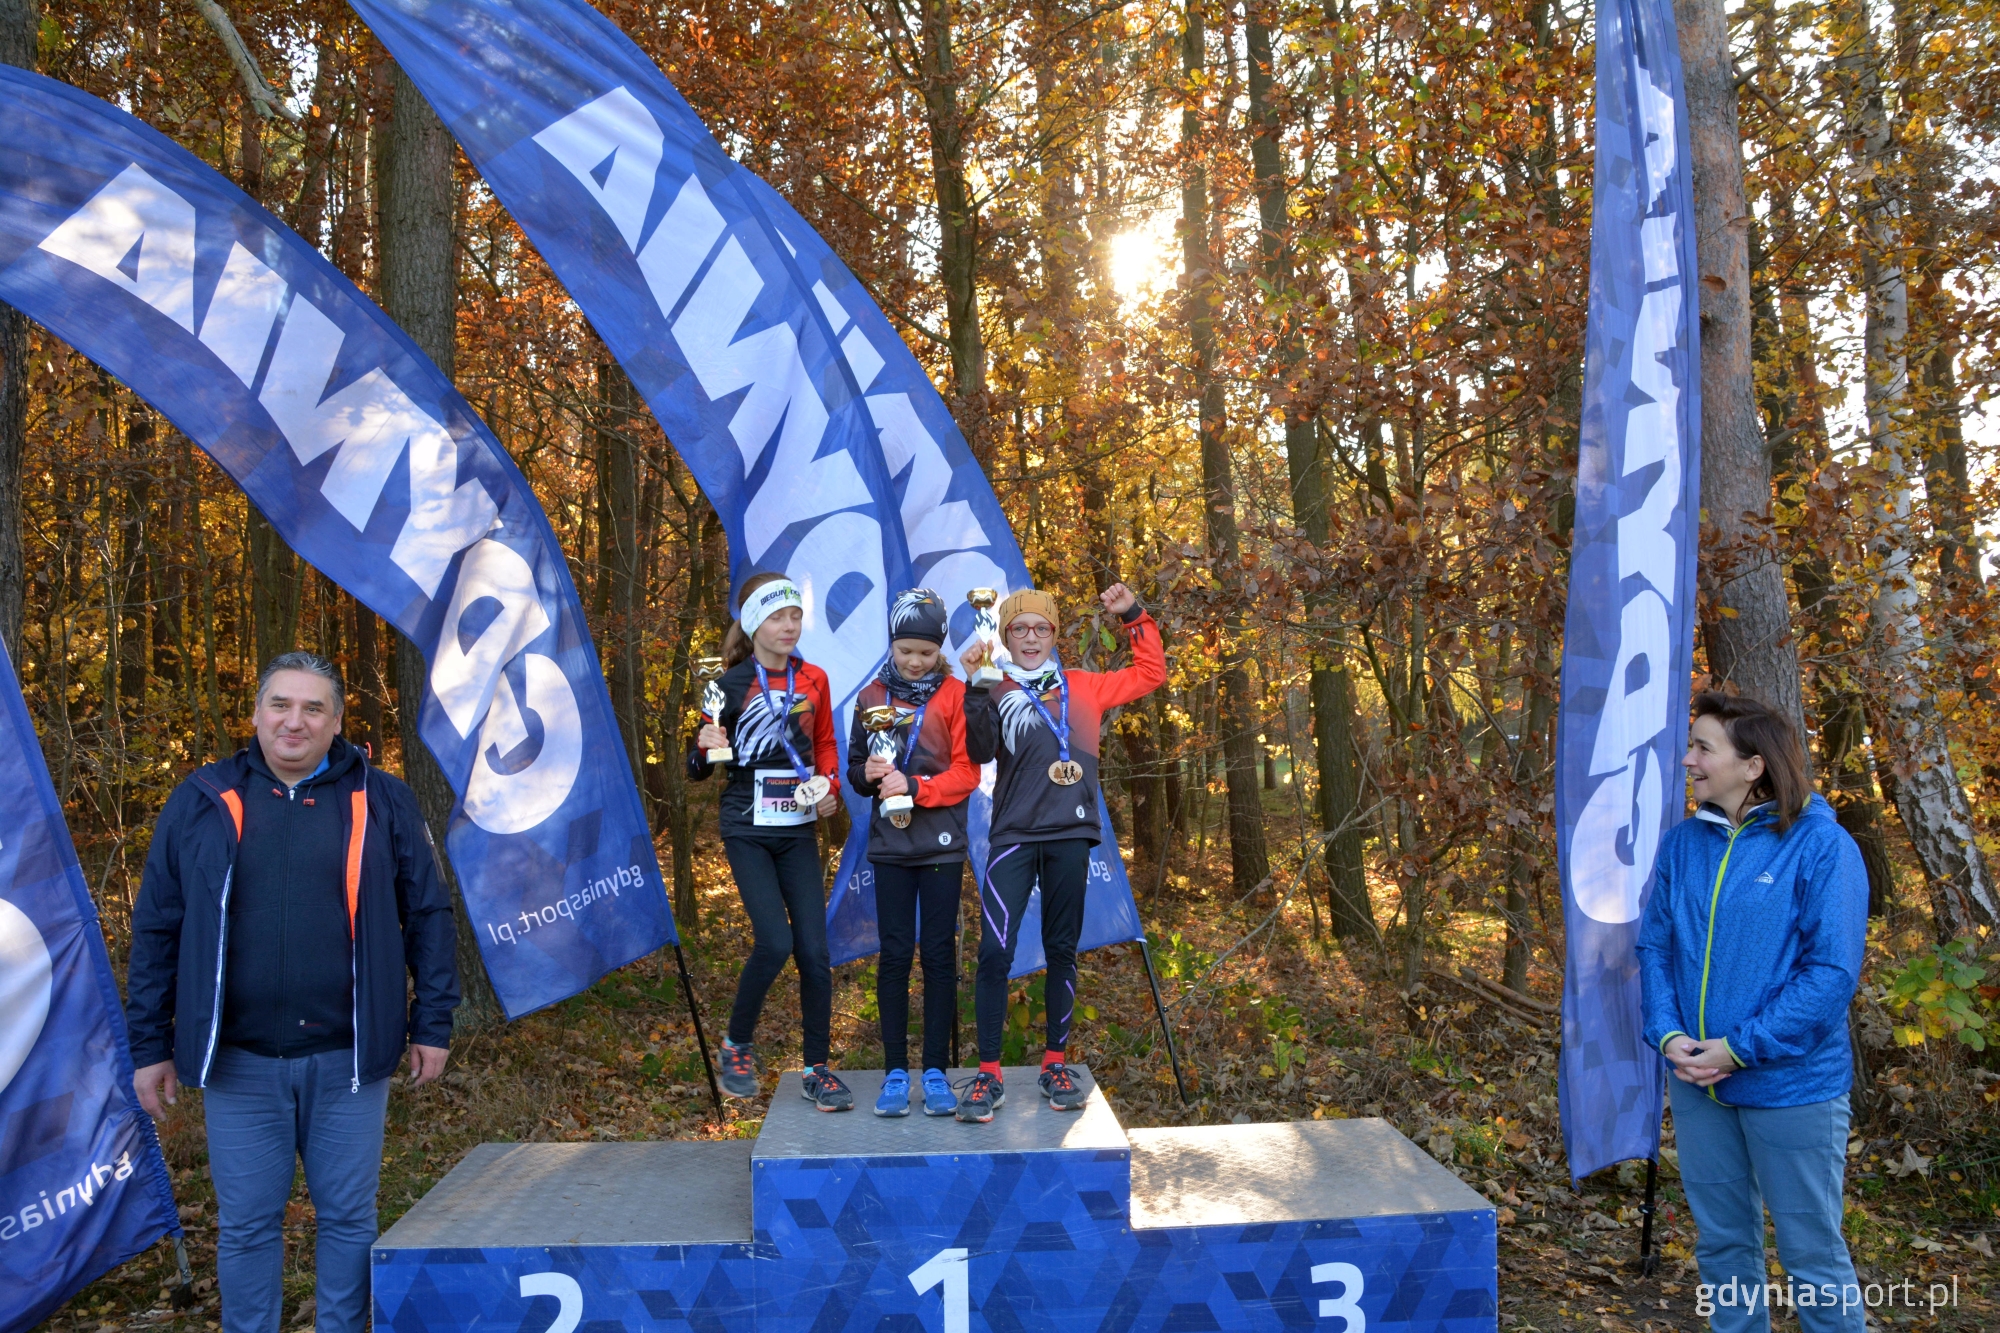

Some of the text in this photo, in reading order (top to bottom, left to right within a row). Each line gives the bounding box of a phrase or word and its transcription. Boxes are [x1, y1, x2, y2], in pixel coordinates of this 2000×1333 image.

[771, 800, 798, 813] 189
[519, 1271, 584, 1333] 2
[907, 1247, 969, 1333] 1
[1310, 1261, 1366, 1333] 3
